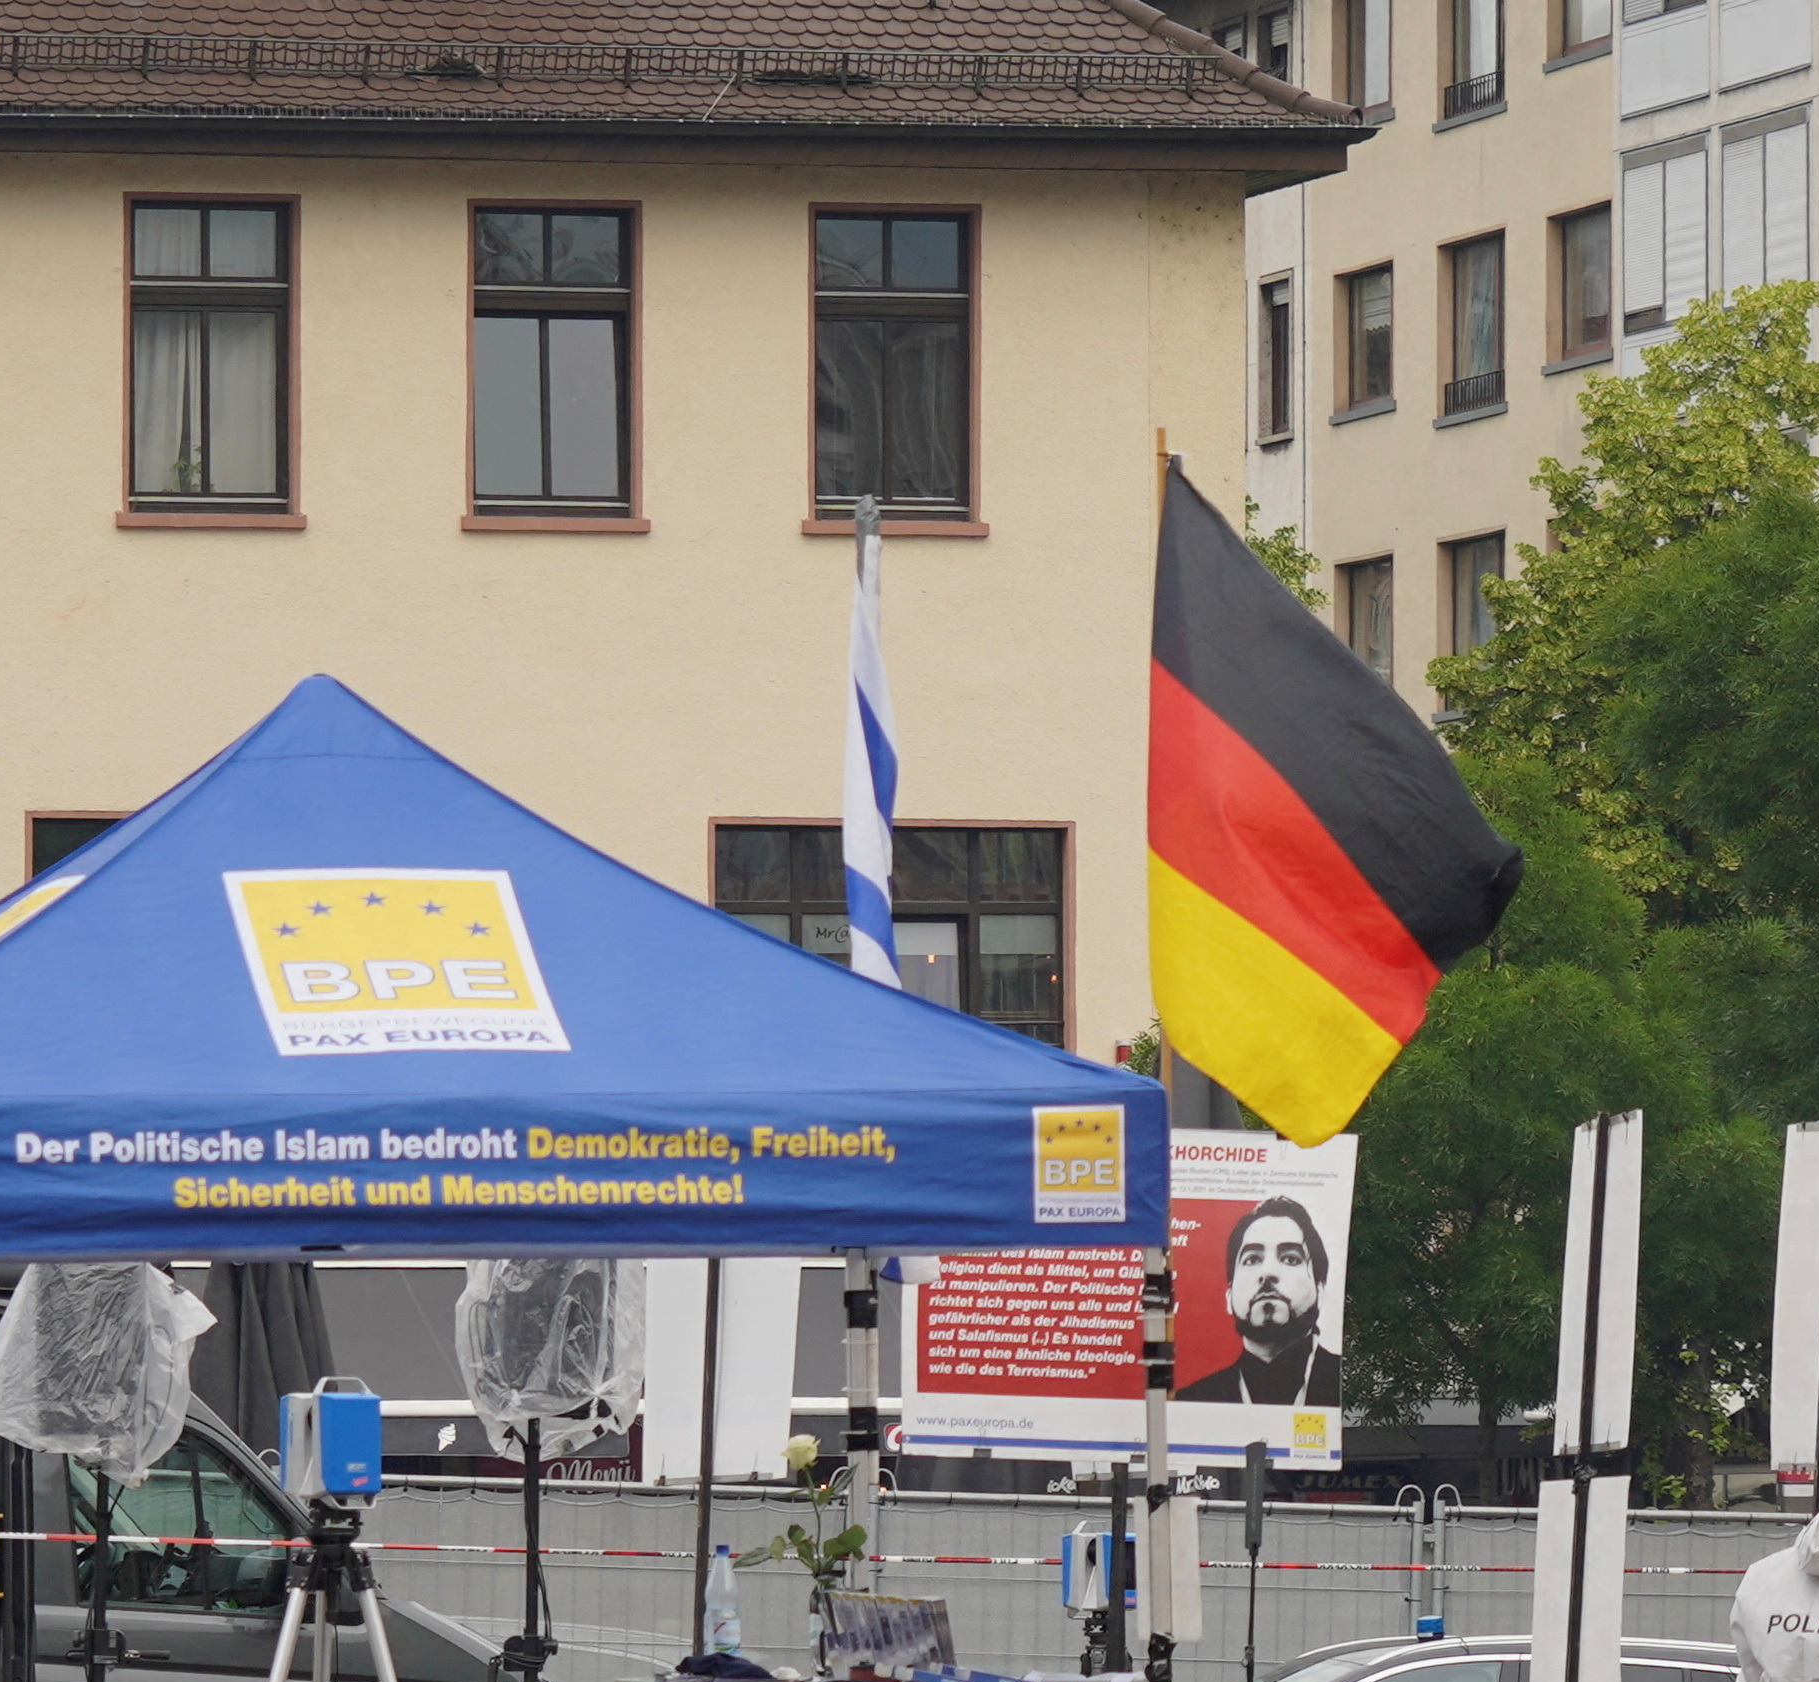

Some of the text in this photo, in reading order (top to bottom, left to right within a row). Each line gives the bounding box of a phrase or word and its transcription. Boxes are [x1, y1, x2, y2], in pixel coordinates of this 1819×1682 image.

[280, 958, 519, 1003] BPE
[288, 1029, 553, 1046] PAX EUROPA
[15, 1125, 896, 1165] Der Politische Islam bedroht Demokratie, Freiheit,
[1044, 1158, 1115, 1186] BPE
[174, 1172, 744, 1208] Sicherheit und Menschenrechte!
[1039, 1206, 1121, 1217] PAX EUROPA
[1068, 1249, 1126, 1262] anstrebt.
[939, 1261, 984, 1276] eligion
[987, 1262, 1022, 1275] dient
[1024, 1263, 1044, 1276] als
[1047, 1263, 1090, 1279] Mittel,
[1093, 1267, 1114, 1278] um
[949, 1279, 1039, 1294] manipulieren.
[1042, 1281, 1067, 1294] Der
[1070, 1281, 1135, 1295] Politische
[929, 1295, 973, 1308] richtet
[976, 1296, 1003, 1308] sich
[1006, 1299, 1048, 1312] gegen
[1050, 1301, 1074, 1311] uns
[1078, 1299, 1102, 1312] alle
[1105, 1301, 1131, 1313] und
[929, 1312, 1135, 1330] gefährlicher als der Jihadismus
[929, 1329, 1123, 1346] und Salafismus Es handelt
[929, 1345, 1135, 1365] sich um eine ähnliche Ideologie
[929, 1362, 952, 1374] wie
[955, 1362, 976, 1375] die
[979, 1363, 1003, 1376] des
[916, 1416, 1034, 1430] www.paxeuropa.de
[1296, 1433, 1324, 1446] BPE
